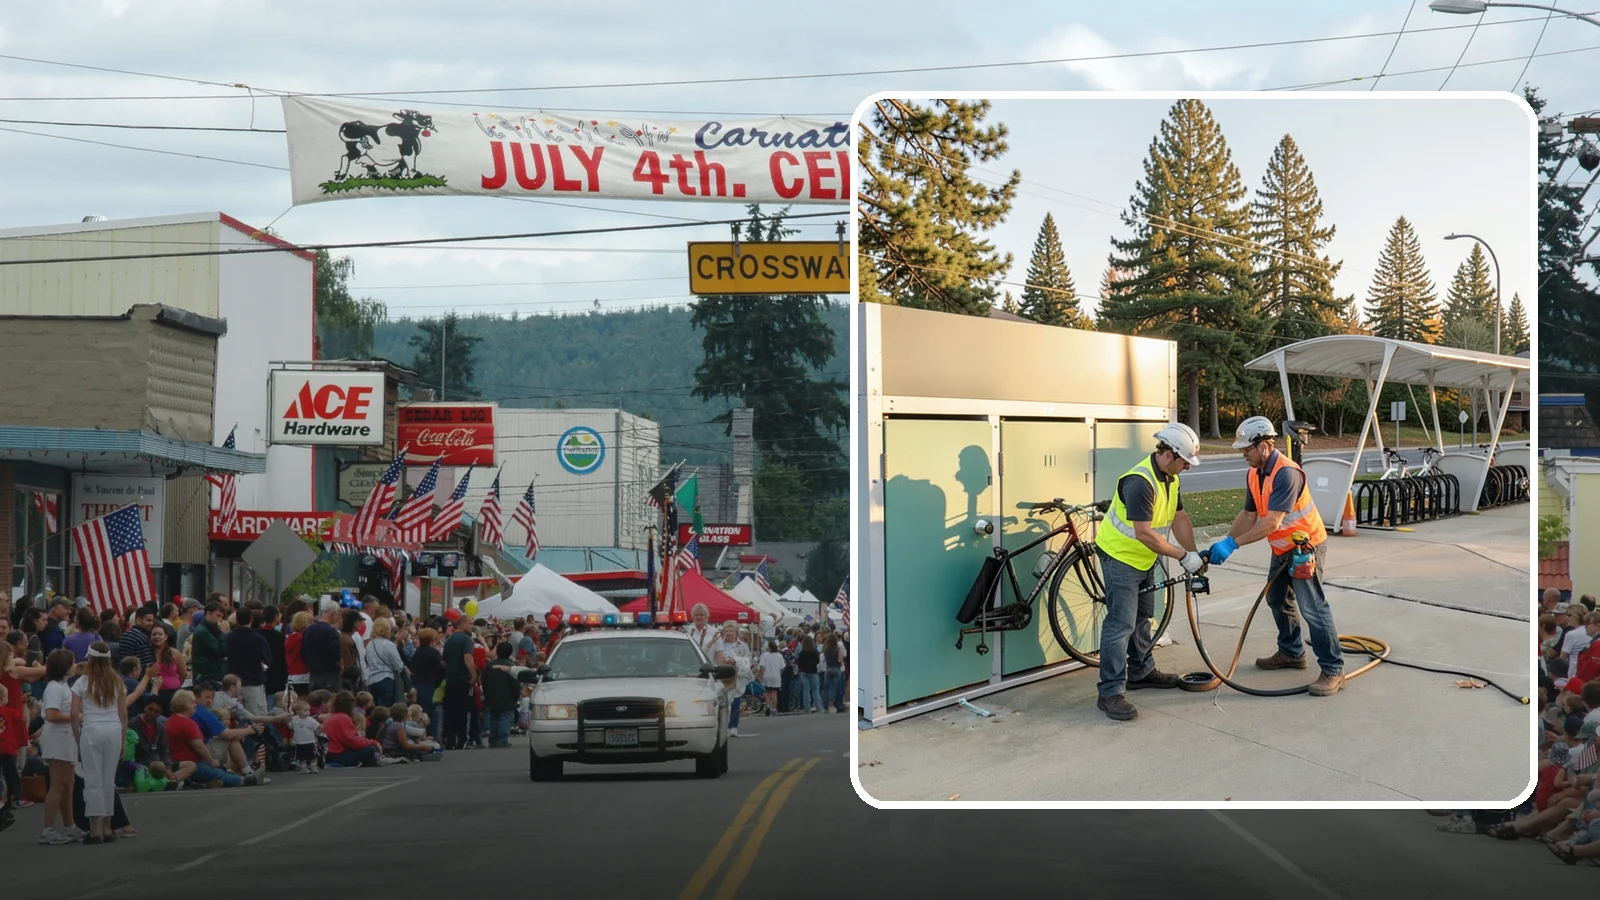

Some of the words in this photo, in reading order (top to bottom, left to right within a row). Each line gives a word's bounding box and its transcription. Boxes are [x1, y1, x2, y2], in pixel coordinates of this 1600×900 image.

[695, 121, 850, 150] Carnat
[481, 141, 604, 192] JULY
[632, 149, 746, 198] 4th.
[697, 254, 850, 280] CROSSWA
[283, 380, 373, 420] ACE
[405, 409, 452, 422] CEDAR
[461, 409, 485, 421] LOG
[284, 421, 371, 437] Hardware
[416, 428, 477, 447] Coca-Cola
[353, 466, 385, 480] Simpl
[83, 485, 93, 494] St.
[96, 485, 124, 495] Vincent
[126, 486, 136, 495] de
[138, 485, 155, 496] Paul
[213, 516, 330, 536] HARDARE
[688, 526, 741, 535] CRNATION
[699, 535, 730, 543] GLASS
